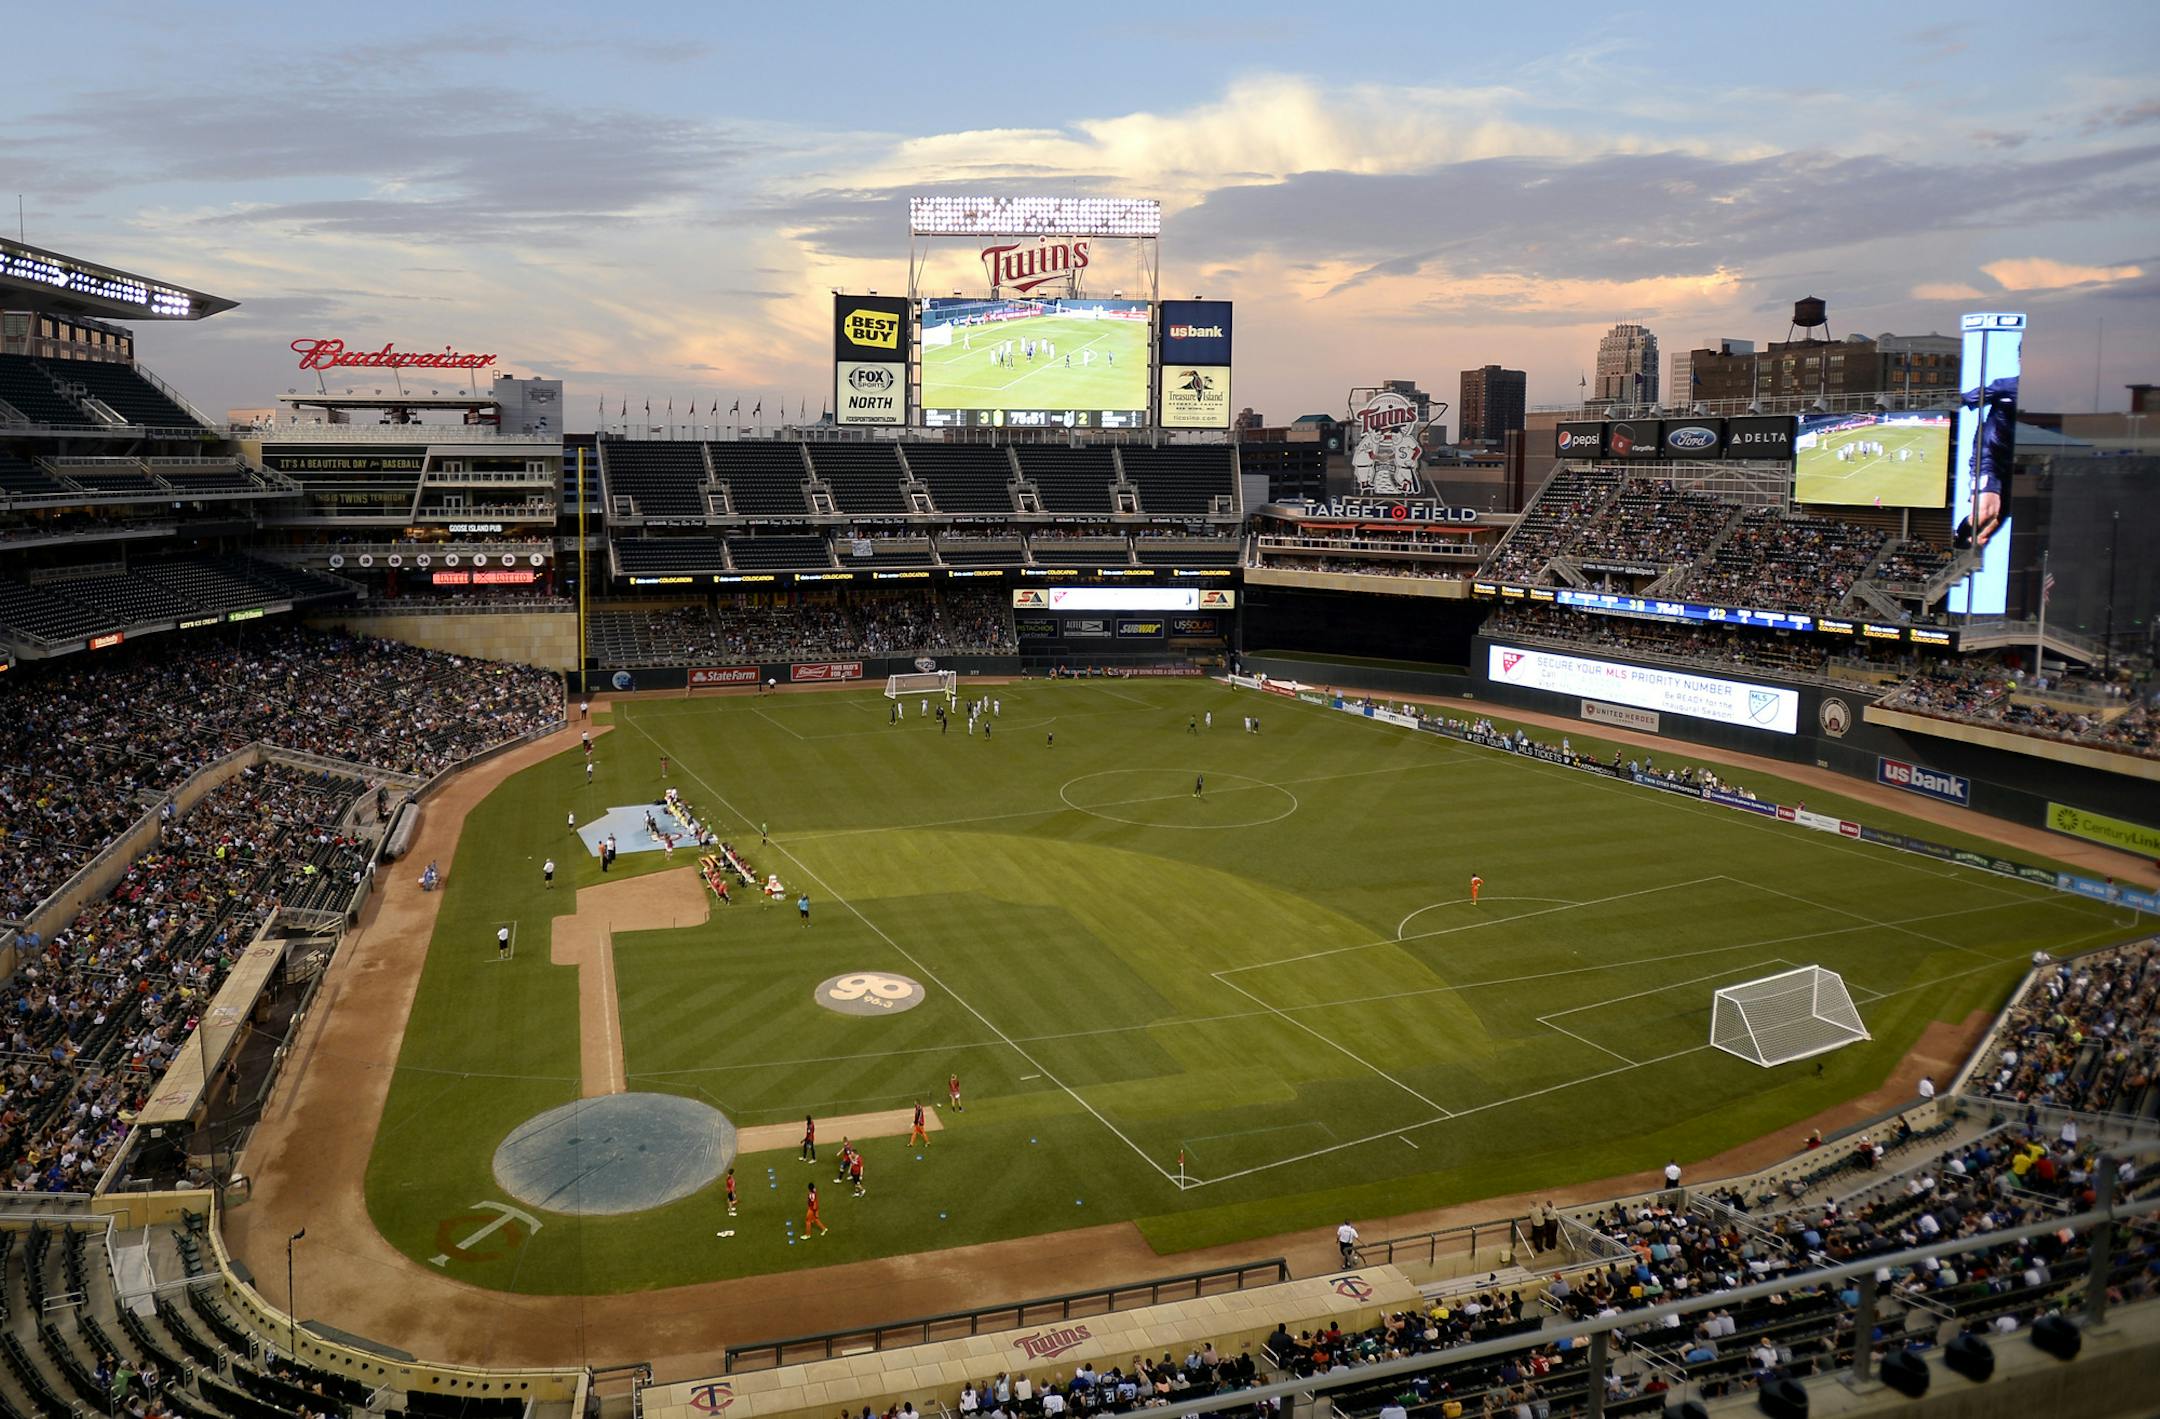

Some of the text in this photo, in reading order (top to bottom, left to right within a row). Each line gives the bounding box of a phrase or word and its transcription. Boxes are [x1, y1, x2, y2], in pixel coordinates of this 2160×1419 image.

[981, 235, 1089, 288] Twins
[852, 316, 897, 331] BEST
[853, 328, 892, 342] BUY
[1170, 325, 1223, 338] usbank
[291, 338, 497, 371] Budweiser
[858, 370, 884, 382] FOX
[848, 396, 893, 409] NORTH
[1168, 391, 1223, 401] Treasure Island
[980, 412, 989, 424] 3
[1078, 412, 1087, 424] 2
[1357, 404, 1417, 433] Twins
[1572, 433, 1600, 447] pepsi
[1677, 430, 1707, 446] Ford
[1745, 432, 1787, 443] DELTA
[280, 459, 298, 469] IT'S
[300, 459, 307, 468] A
[307, 459, 351, 469] BEAUTIFUL
[352, 459, 366, 469] DAY
[382, 459, 420, 469] BASEBALL
[340, 493, 368, 504] TWINS
[370, 494, 406, 502] TERRITORY
[1304, 503, 1477, 522] TARGET FIELD
[449, 525, 502, 533] GOOSE ISLAND PUB
[1016, 624, 1054, 632] PISTACHIOS
[1120, 623, 1161, 633] SUBWAY
[1818, 626, 1853, 635] COLOCATION
[1864, 631, 1900, 640] COLOCATION
[1911, 636, 1950, 645] COLOCATION
[924, 660, 935, 669] 29
[1537, 657, 1574, 671] SECURE
[1576, 662, 1602, 675] YOUR
[1606, 667, 1628, 680] MLS
[1631, 671, 1681, 689] PRIORITY
[1683, 679, 1733, 696] NUMBER
[1664, 691, 1674, 699] Be
[1705, 696, 1718, 707] for
[1719, 699, 1733, 710] the
[1751, 693, 1768, 702] MLS
[1596, 706, 1656, 725] UNITED HEROES
[1472, 734, 1504, 748] GET YOUR
[1518, 744, 1563, 763] MLS TICKETS
[1885, 762, 1964, 798] usbank
[1670, 782, 1700, 796] ORTHOPEDICS
[2082, 819, 2160, 850] CenturyLink
[1955, 852, 1989, 867] SUMMIT
[2020, 868, 2055, 883] SUMMIT
[1013, 1325, 1092, 1360] Twins
[1105, 1392, 1115, 1403] 21
